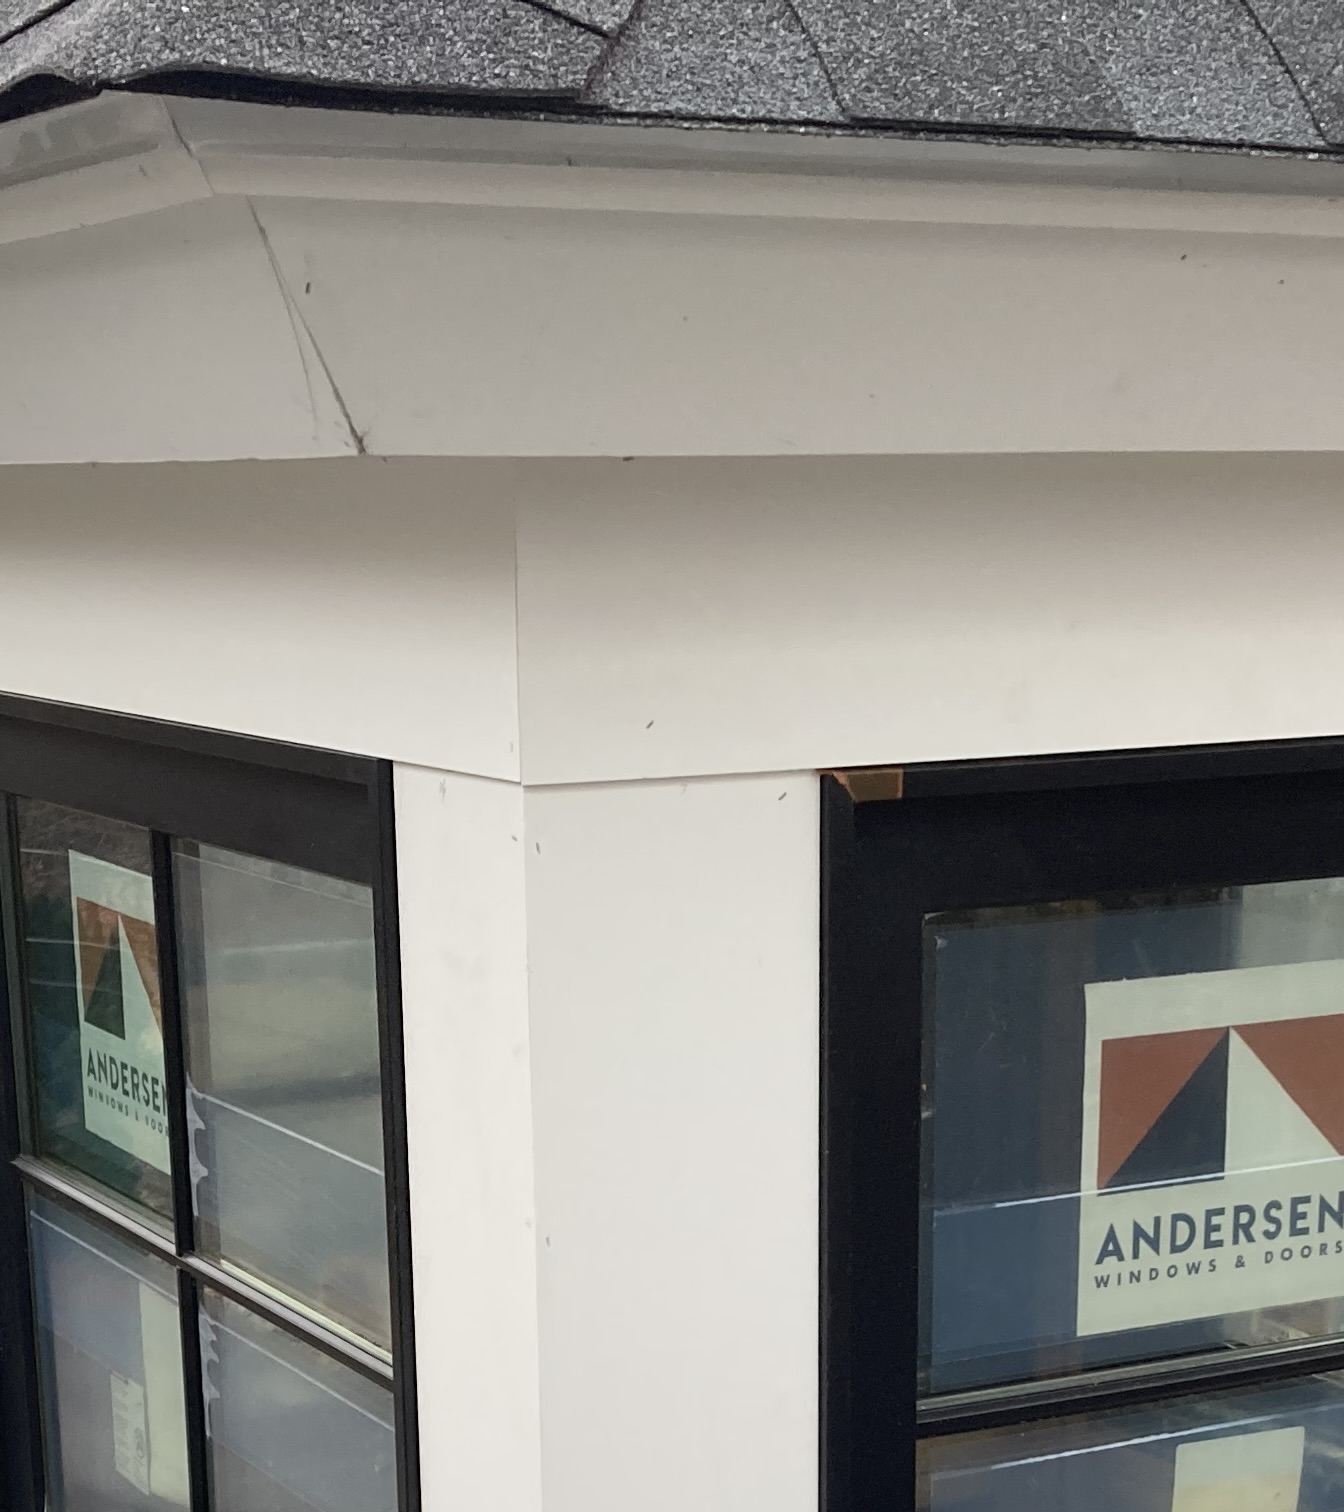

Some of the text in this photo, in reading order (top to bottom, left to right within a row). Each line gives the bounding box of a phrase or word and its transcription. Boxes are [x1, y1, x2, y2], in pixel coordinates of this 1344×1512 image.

[1094, 1240, 1343, 1289] WINDOWS & DOORS
